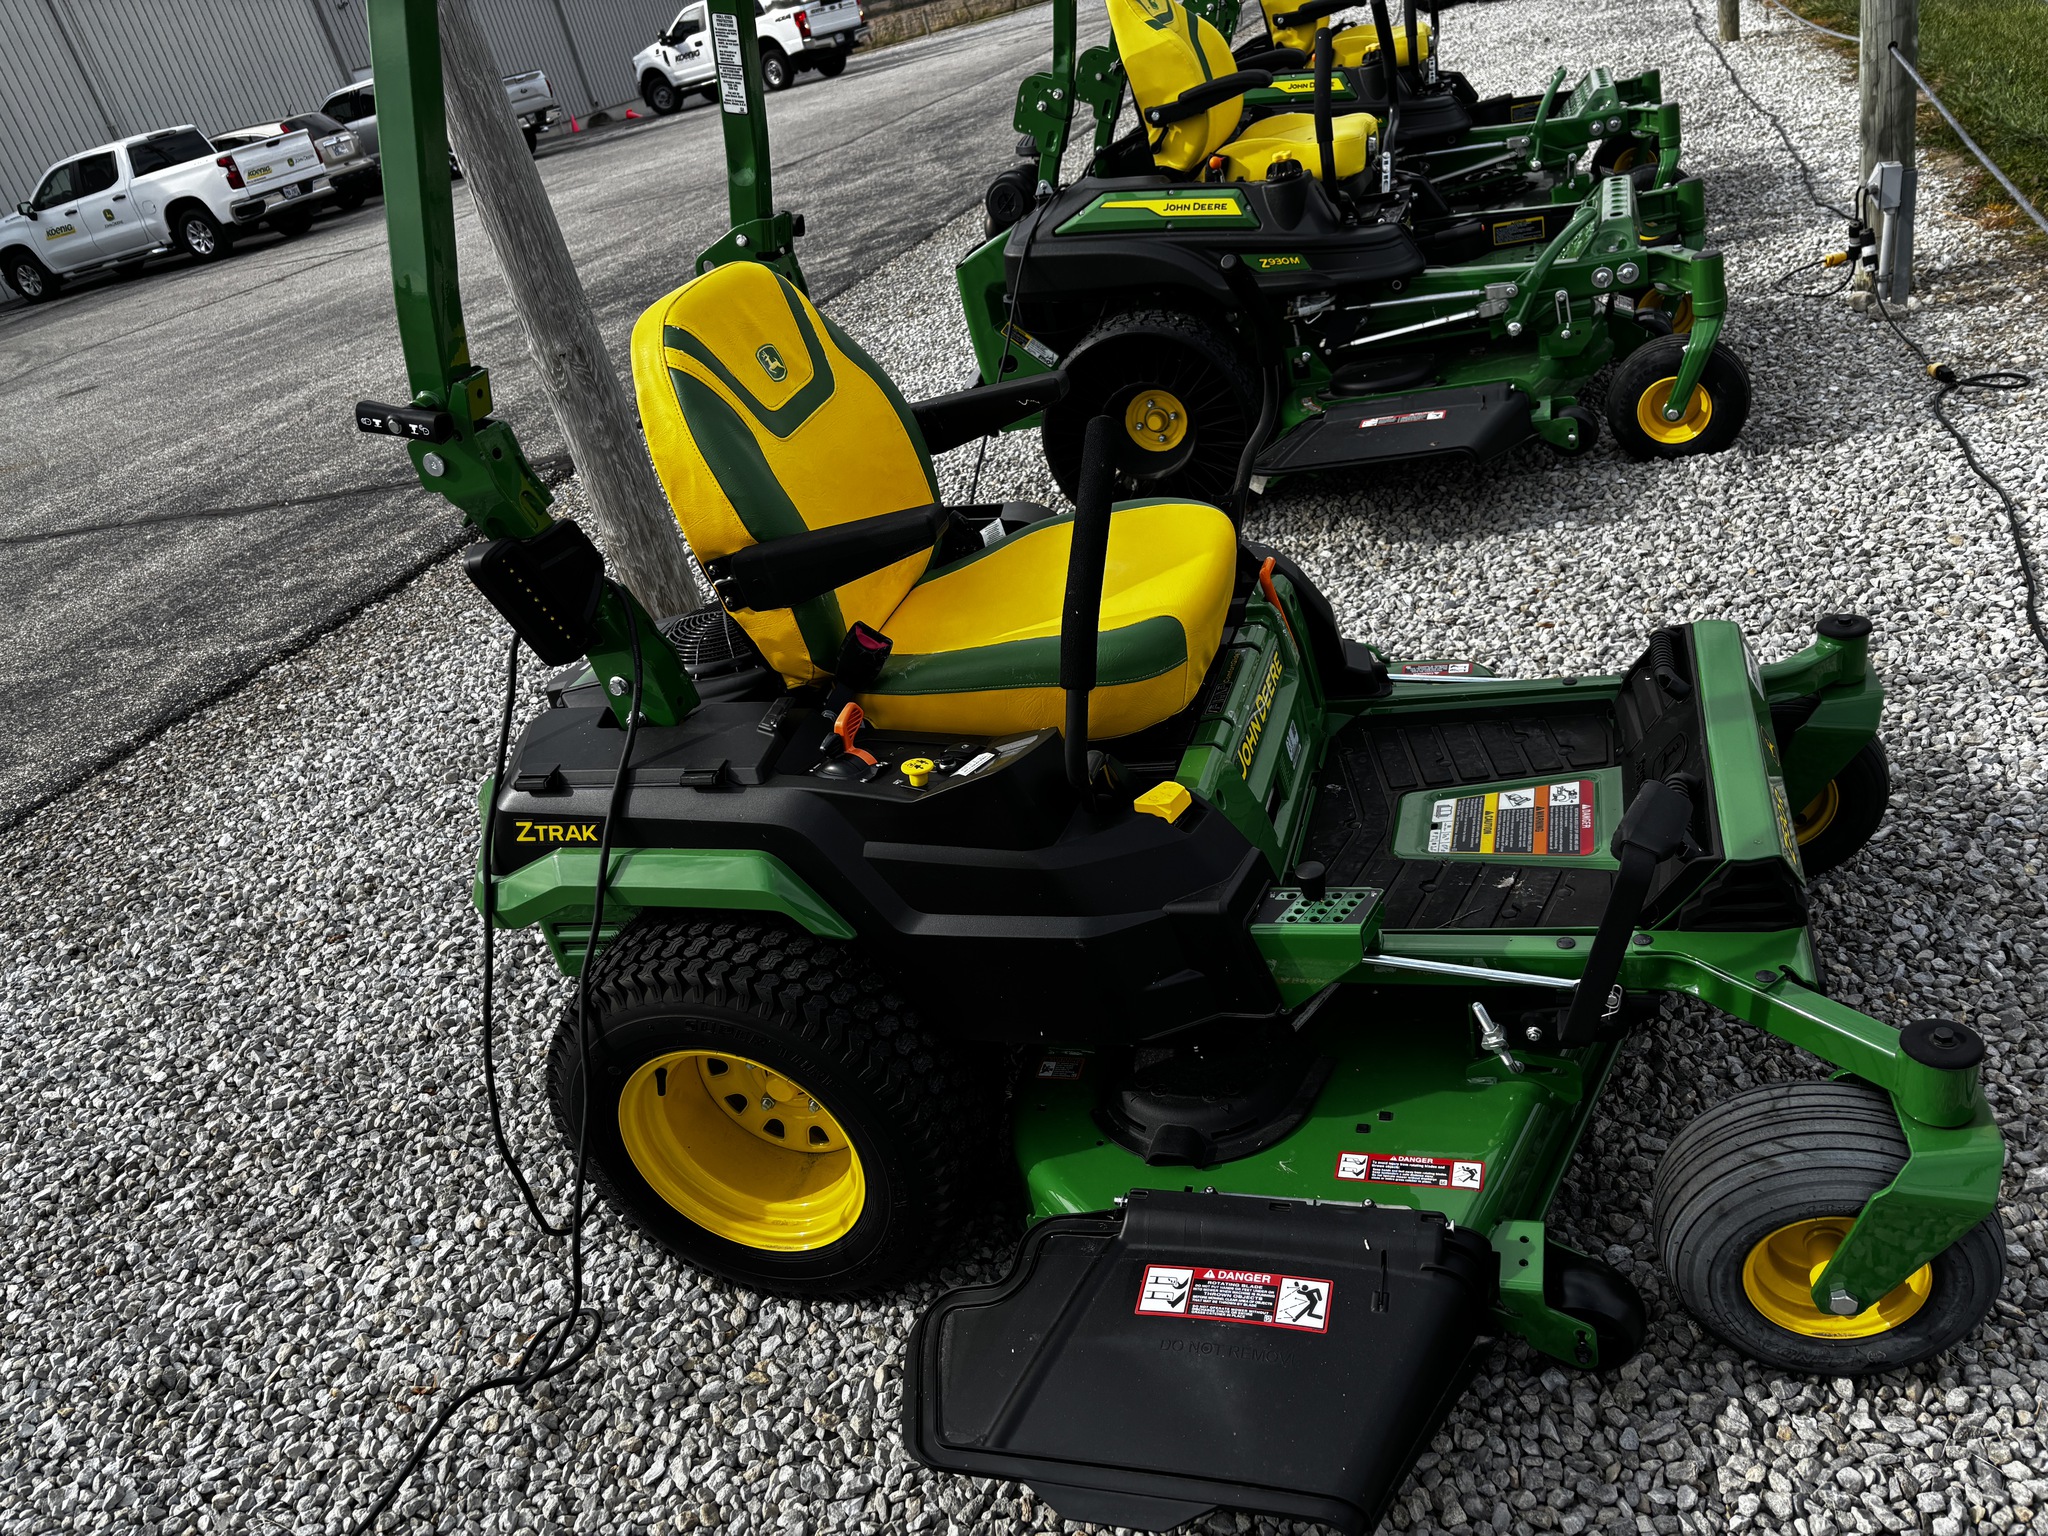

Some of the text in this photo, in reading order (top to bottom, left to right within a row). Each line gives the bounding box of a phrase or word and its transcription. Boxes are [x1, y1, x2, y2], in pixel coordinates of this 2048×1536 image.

[1163, 202, 1228, 212] JOHN DEERE
[1258, 256, 1301, 269] Z930M
[1237, 651, 1283, 781] JOHN DEERE
[1483, 815, 1494, 835] CAUTION
[1535, 811, 1545, 834] WARNING
[1581, 809, 1591, 829] DANGER
[515, 821, 599, 842] ZTRAK
[1398, 1155, 1434, 1164] DANGER
[1217, 1270, 1272, 1284] DANGER
[1160, 1339, 1184, 1352] DO
[1188, 1340, 1224, 1356] NOT
